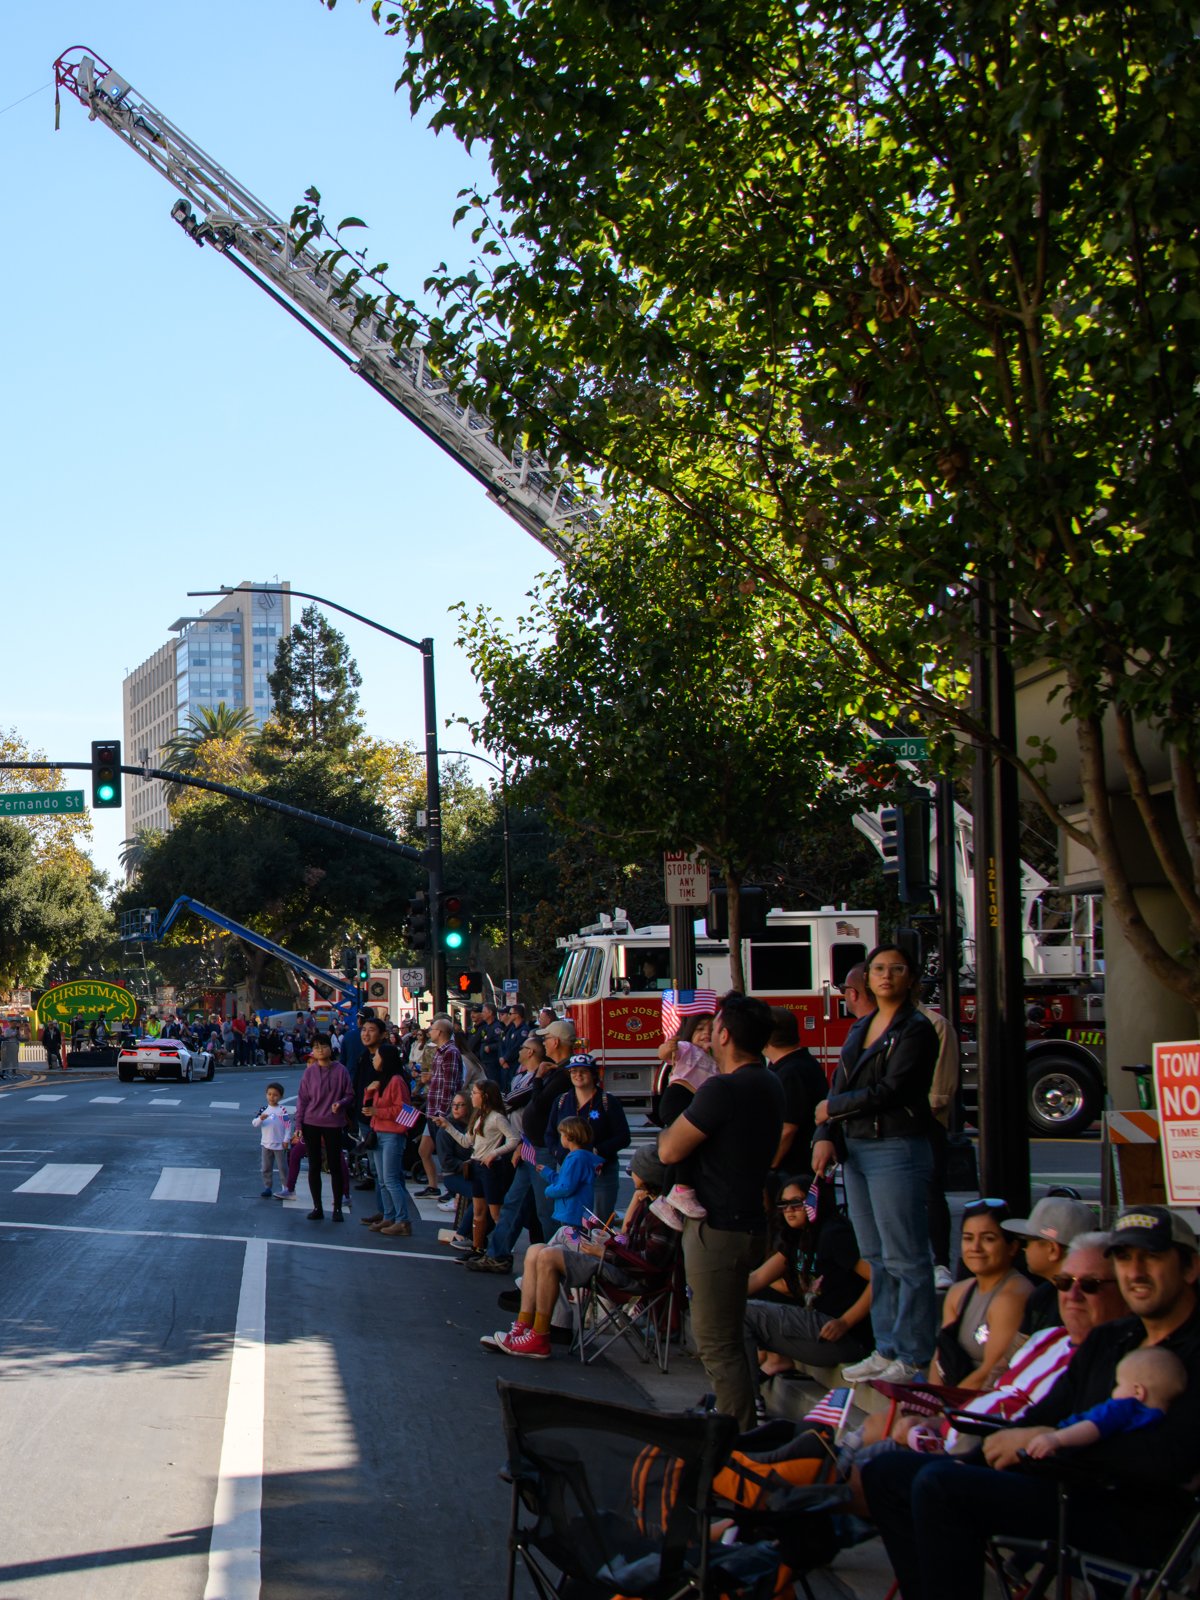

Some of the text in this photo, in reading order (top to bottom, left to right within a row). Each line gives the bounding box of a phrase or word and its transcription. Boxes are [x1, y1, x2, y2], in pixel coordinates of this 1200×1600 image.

[65, 796, 79, 808] St
[667, 863, 706, 875] STOPPING
[679, 877, 695, 886] ANY
[679, 888, 696, 897] TIME
[42, 984, 130, 1009] CHRISTMAS
[608, 1006, 660, 1018] SAN JOSE
[607, 1029, 632, 1041] FIRE
[1170, 1128, 1199, 1137] TIME
